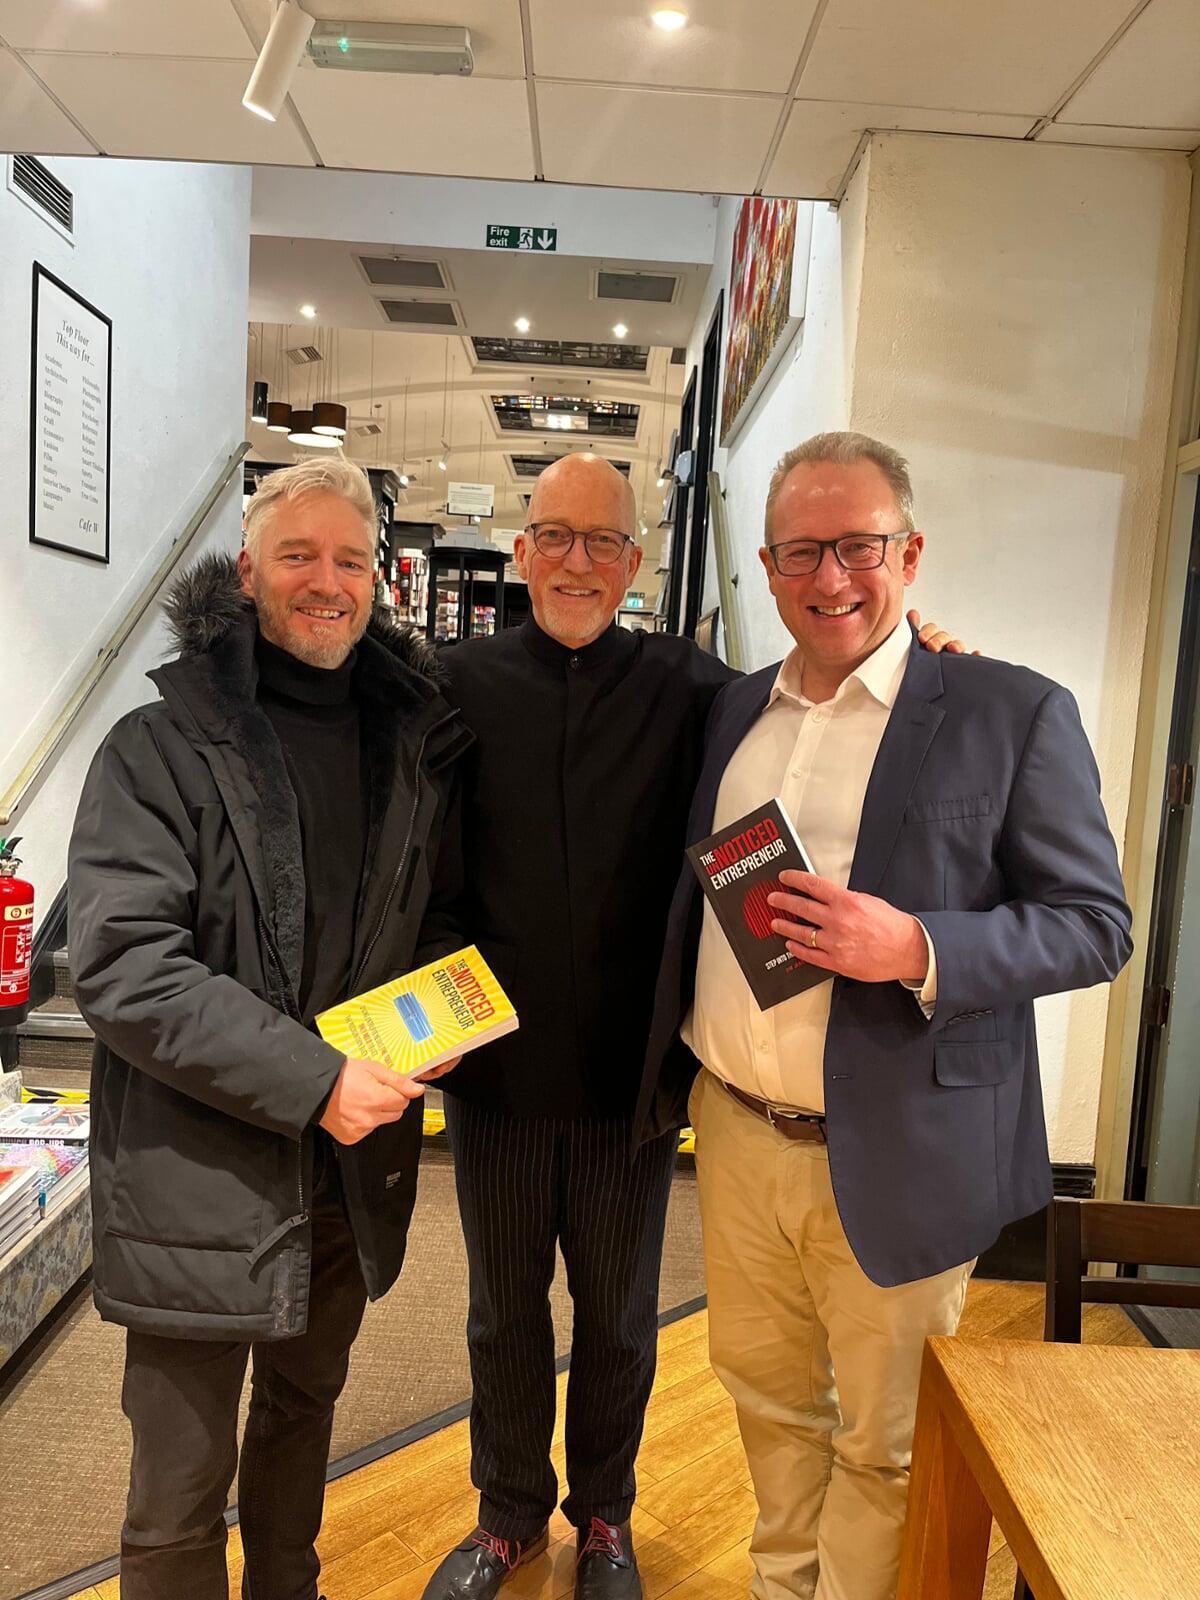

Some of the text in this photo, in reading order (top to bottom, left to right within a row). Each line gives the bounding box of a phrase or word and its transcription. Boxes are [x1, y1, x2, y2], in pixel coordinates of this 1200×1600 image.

[491, 226, 510, 236] Fire
[490, 237, 508, 247] exit
[62, 320, 90, 347] Top Floor
[56, 331, 69, 349] This
[70, 344, 81, 359] way
[699, 850, 717, 867] THE
[710, 838, 787, 890] ENTREPRENEUR
[455, 958, 468, 971] THE
[765, 957, 777, 970] STEP
[432, 968, 475, 1030] ENTREPRENEUR
